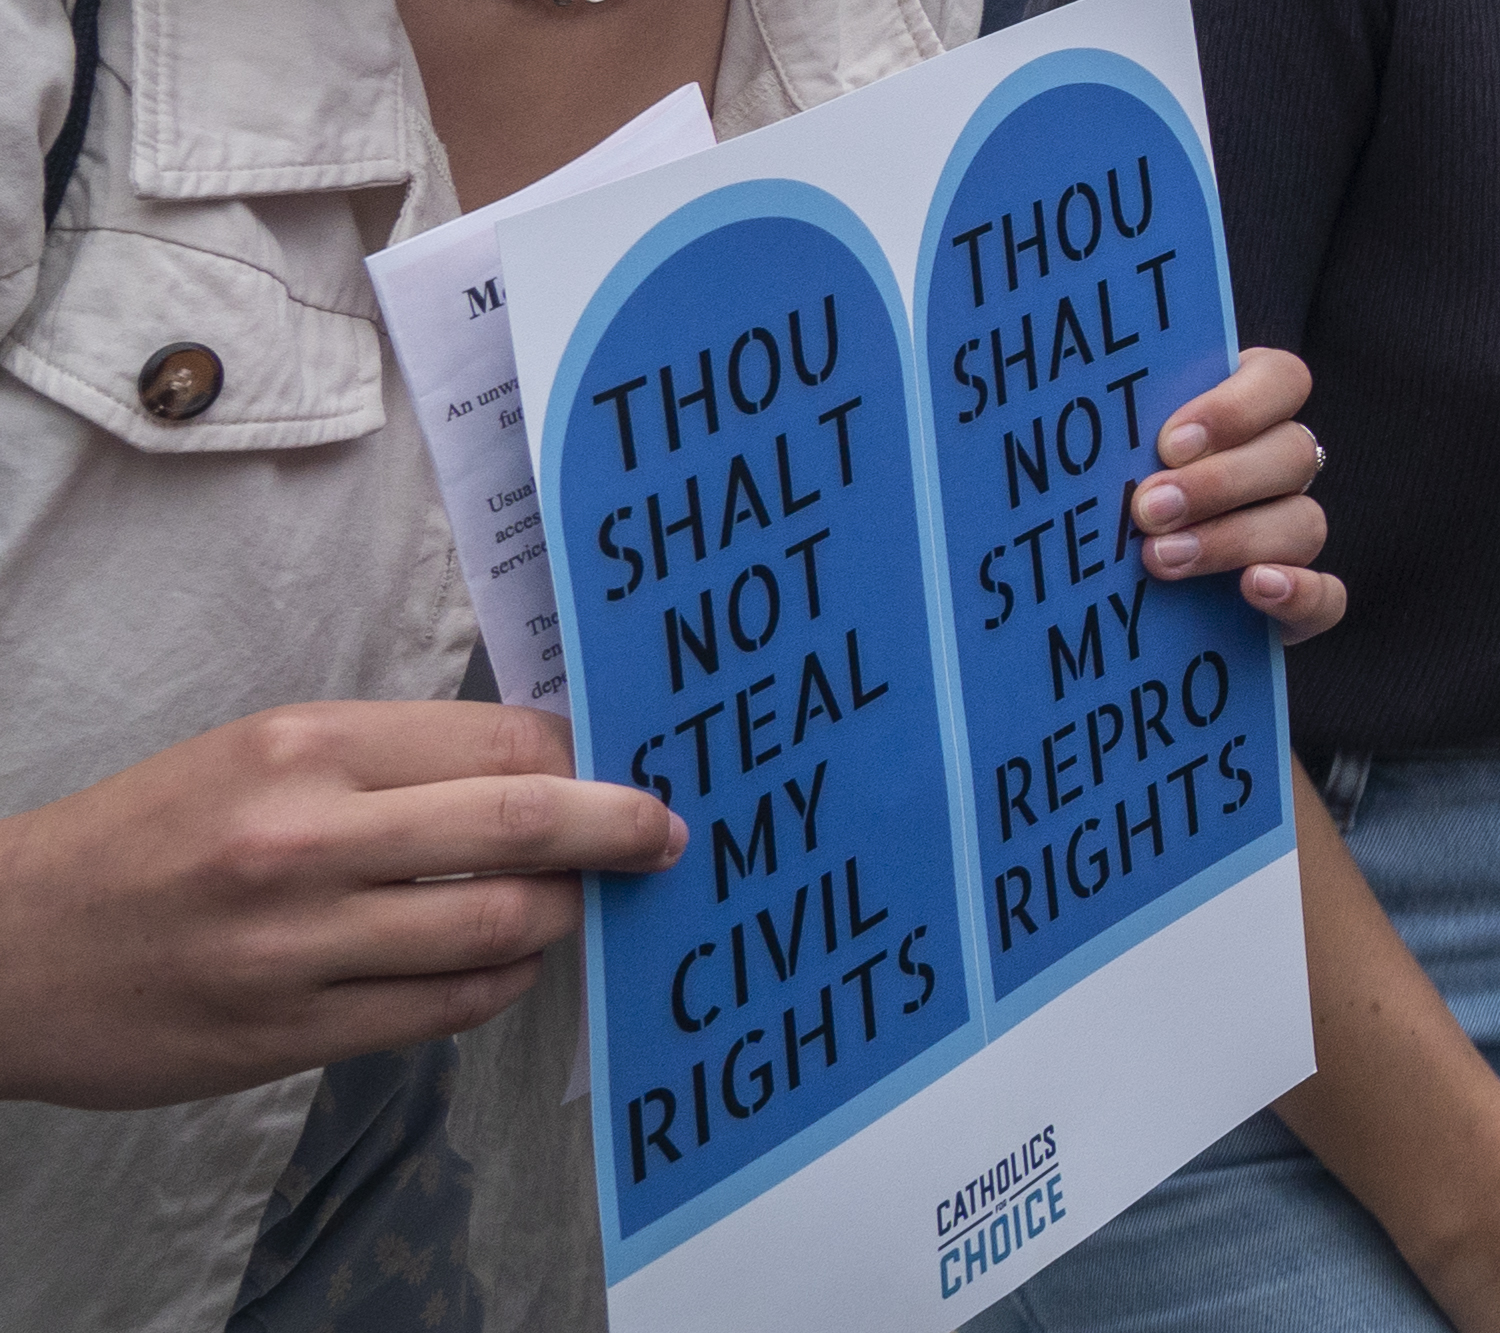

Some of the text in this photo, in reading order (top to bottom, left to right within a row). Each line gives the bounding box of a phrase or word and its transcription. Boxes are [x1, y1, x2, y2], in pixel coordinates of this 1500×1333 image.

[952, 155, 1152, 308] THOU
[447, 400, 473, 422] An
[593, 294, 839, 471] THOU
[954, 249, 1176, 424] SHALT
[598, 395, 862, 601] SHALT
[1003, 367, 1149, 510] NOT
[664, 527, 830, 694] NOT
[979, 478, 1141, 631] STEA
[631, 628, 889, 806] STEAL
[1047, 578, 1147, 702] MY
[995, 650, 1228, 844] REPRO
[711, 759, 828, 904] MY
[994, 734, 1252, 953] RIGHTS
[671, 856, 889, 1033] CIVIL
[628, 924, 936, 1185] RIGHTS
[937, 1124, 1056, 1237] CATHOLICS
[940, 1173, 1066, 1300] CHOICE
[995, 1199, 1007, 1214] FOR
